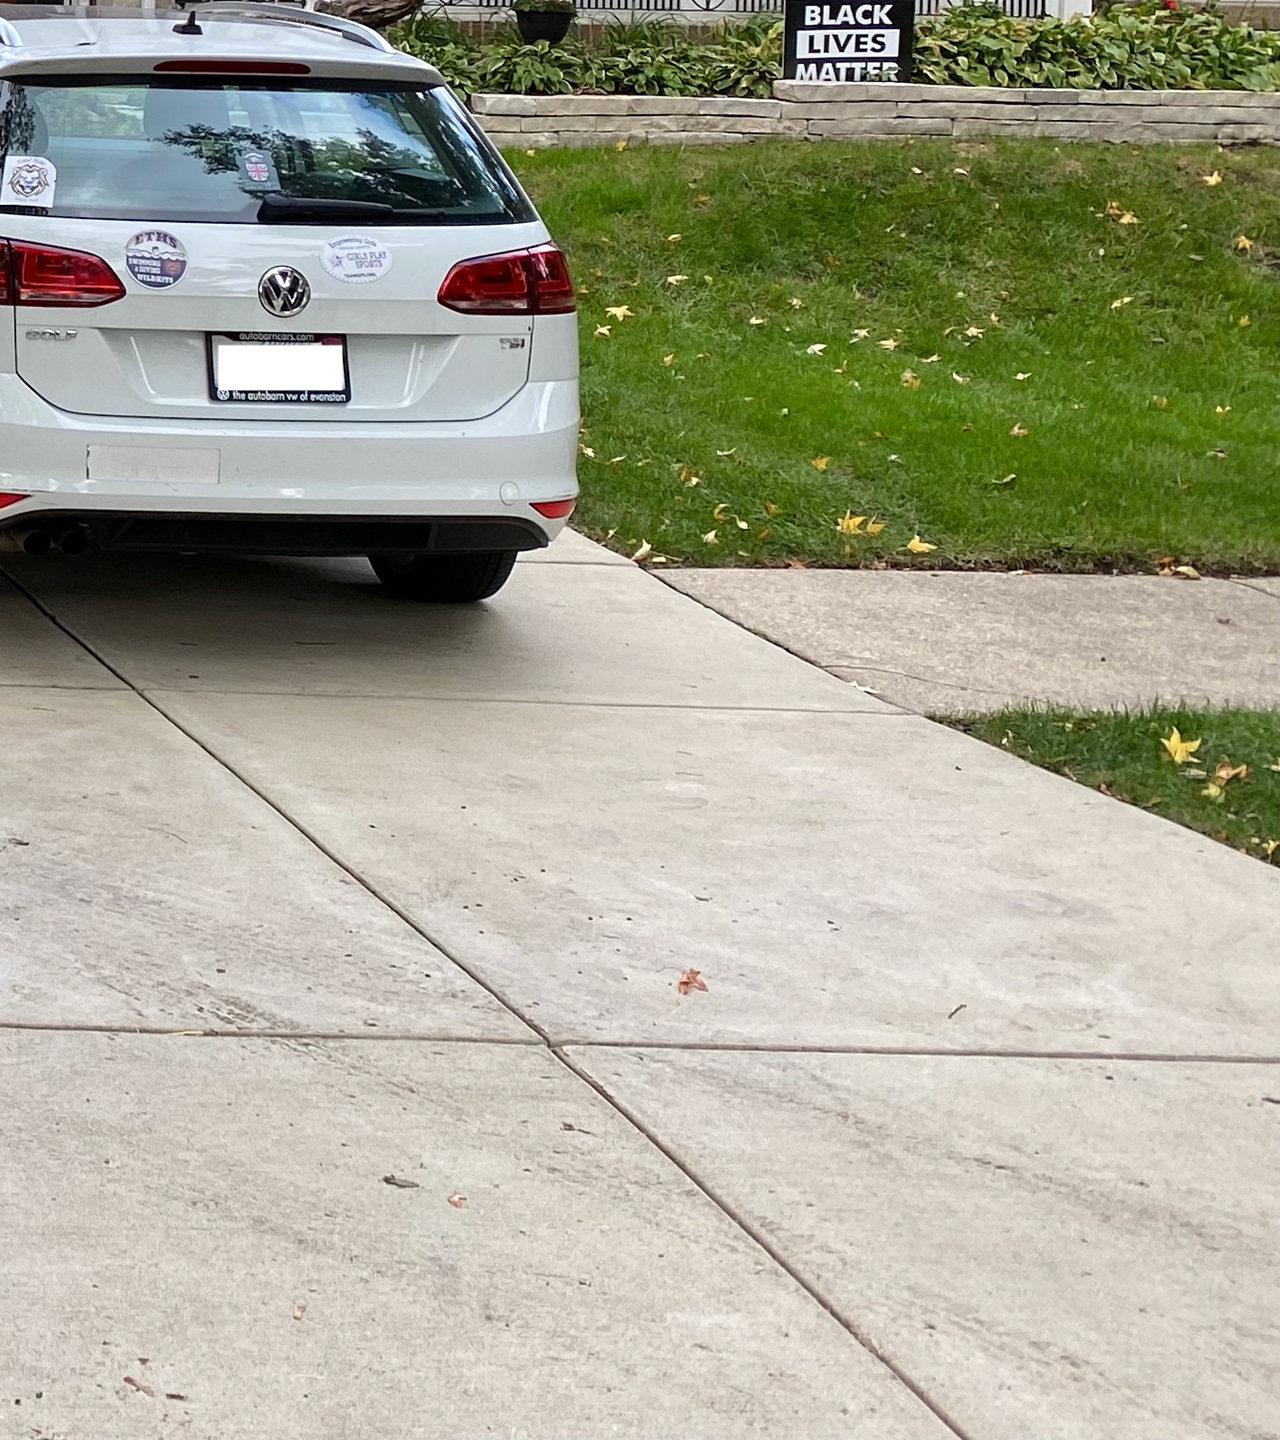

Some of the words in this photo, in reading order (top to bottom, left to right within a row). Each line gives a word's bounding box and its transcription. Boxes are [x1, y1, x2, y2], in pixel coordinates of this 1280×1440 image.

[804, 4, 894, 26] BLACK
[808, 33, 887, 54] LIVES
[135, 231, 177, 249] ETHS
[25, 328, 78, 342] GOLF
[239, 332, 315, 342] autobarncars.com
[232, 390, 246, 400] the
[247, 389, 285, 401] autobarn
[286, 393, 299, 401] vw
[299, 389, 309, 401] of
[310, 391, 346, 402] evanston
